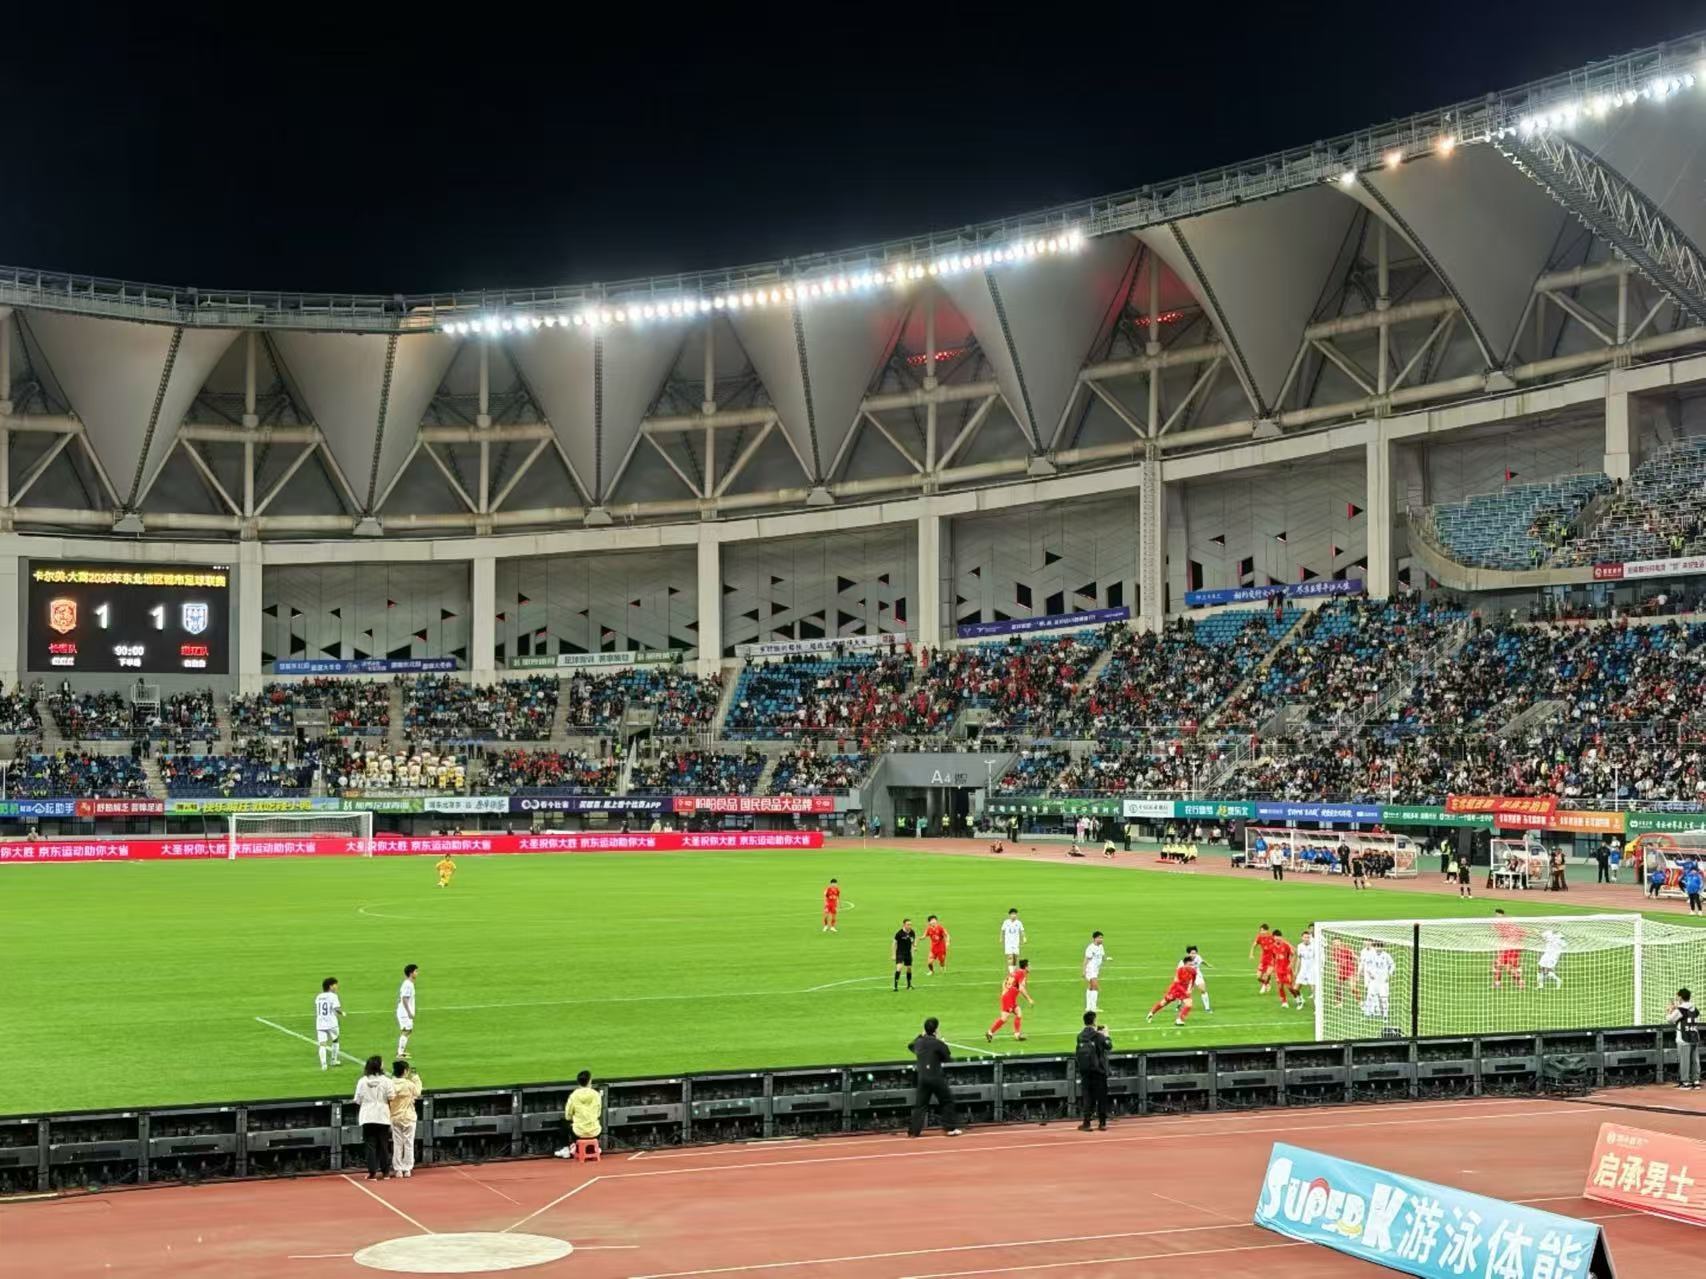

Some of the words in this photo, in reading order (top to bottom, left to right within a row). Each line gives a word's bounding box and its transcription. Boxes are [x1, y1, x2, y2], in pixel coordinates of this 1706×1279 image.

[95, 603, 108, 629] 1
[152, 605, 164, 630] 1
[695, 798, 738, 811] 盼盼食品
[740, 798, 812, 811] 国民食品大品牌
[411, 839, 491, 852] 京东运动助你大省
[519, 838, 577, 850] 大圣祝你大胜
[580, 837, 655, 849] 京东运动助你大省
[681, 836, 736, 847] 大圣祝你大胜
[740, 835, 811, 846] 京东运动助你大省
[39, 845, 129, 858] 京东运动助你大省
[1398, 1195, 1582, 1279] 游泳体能
